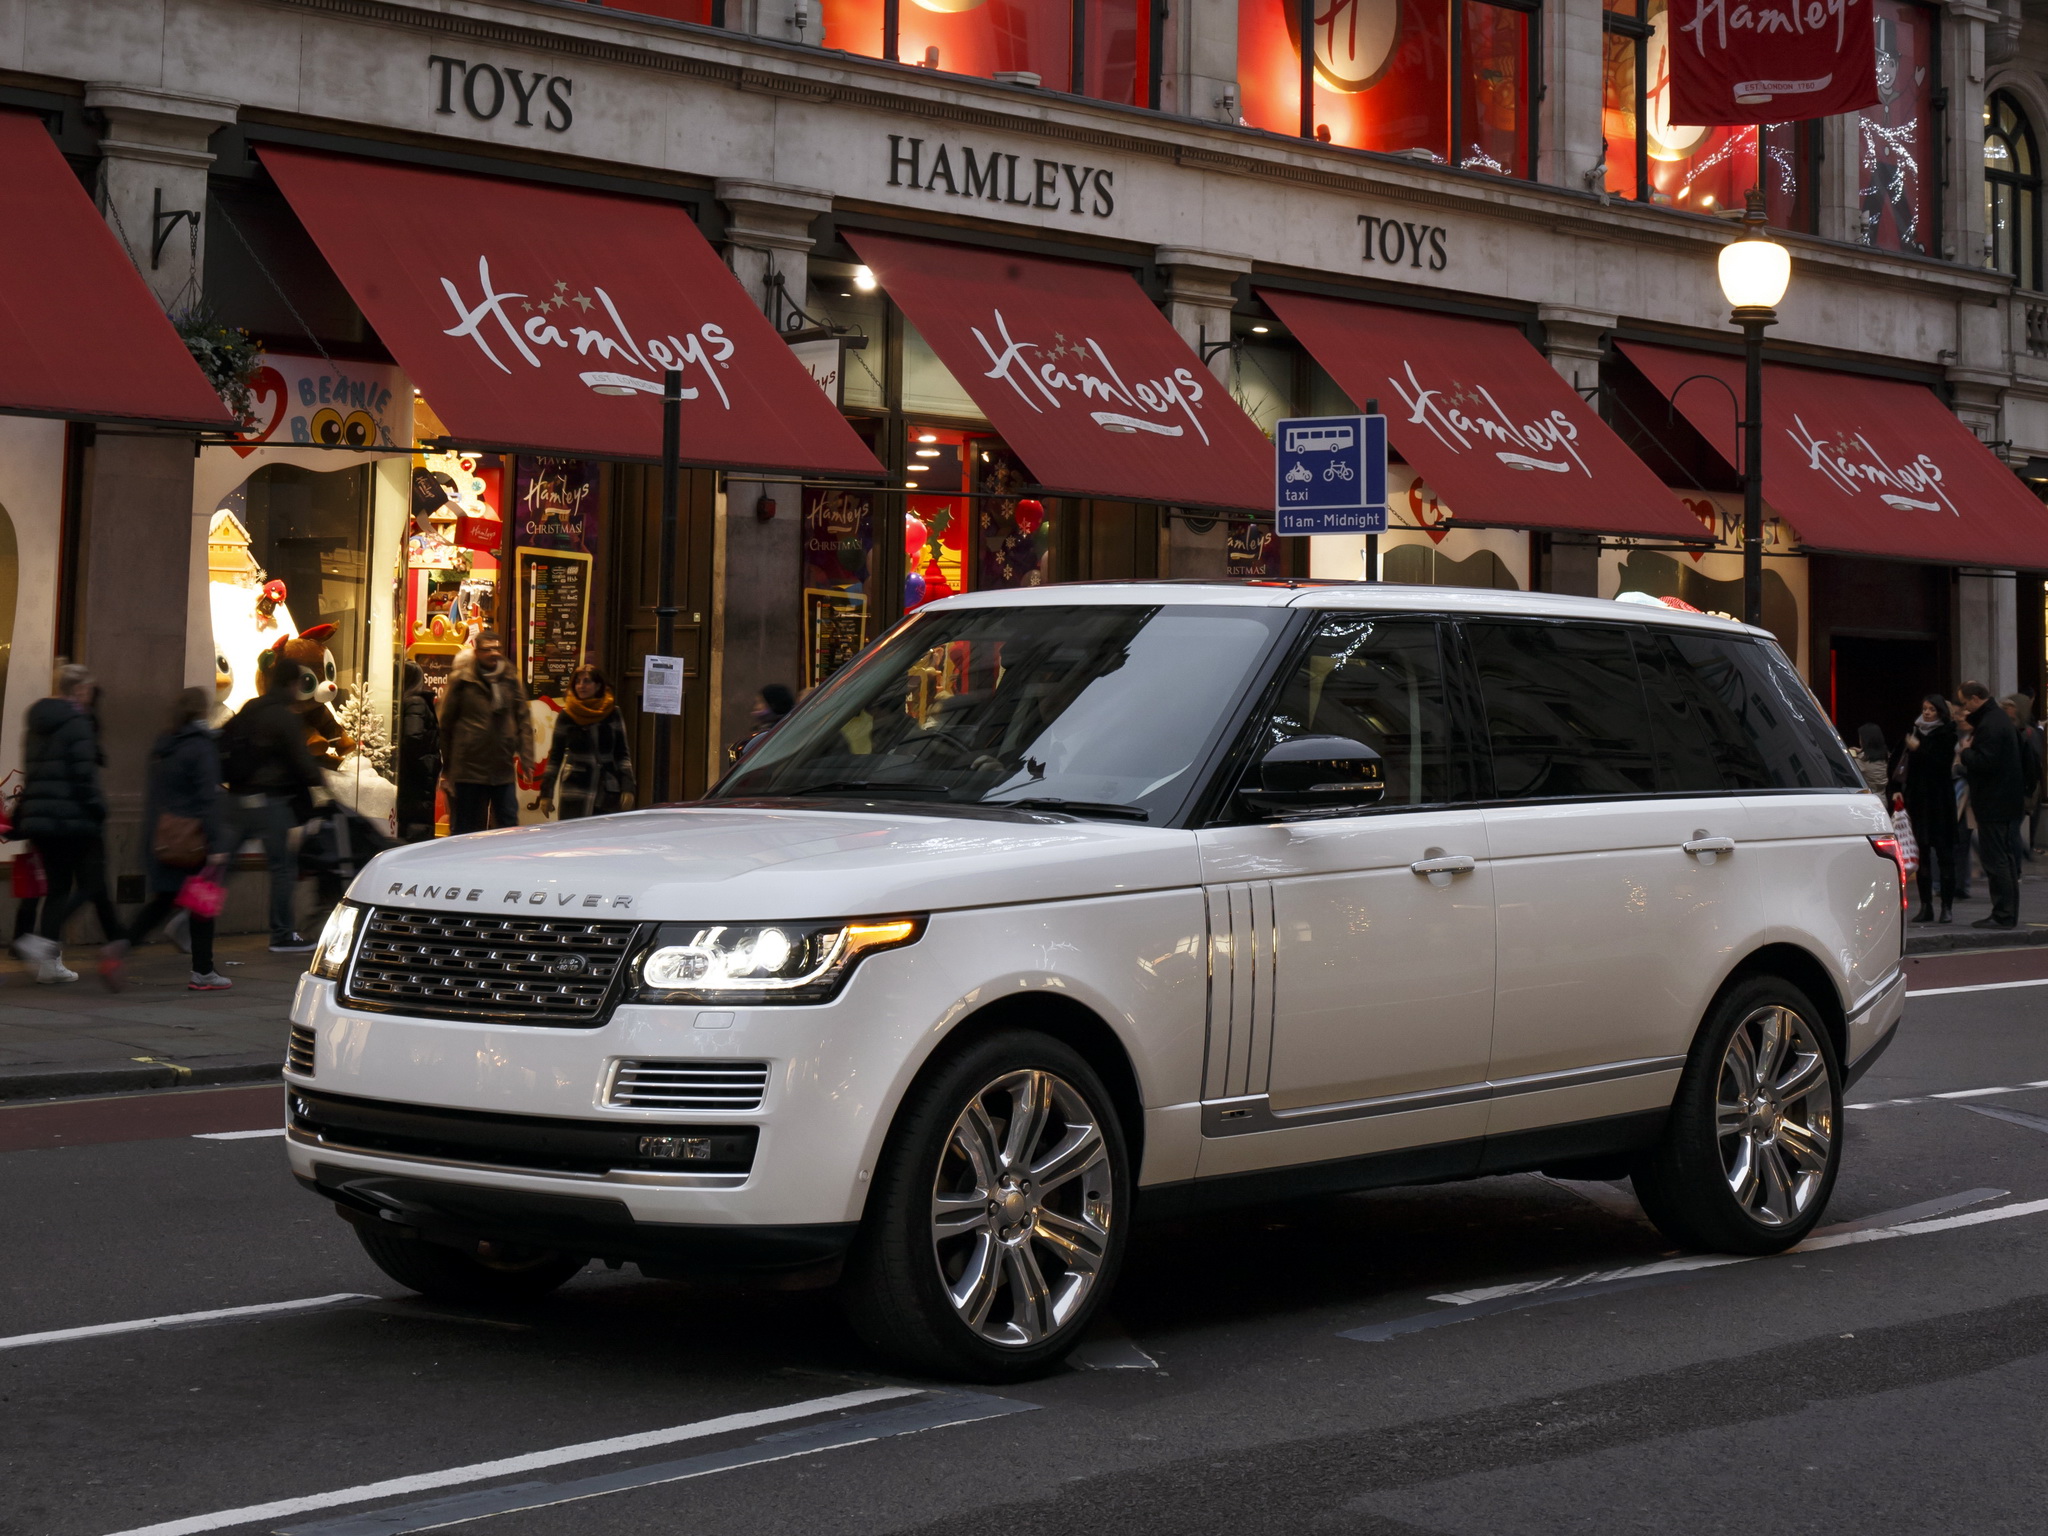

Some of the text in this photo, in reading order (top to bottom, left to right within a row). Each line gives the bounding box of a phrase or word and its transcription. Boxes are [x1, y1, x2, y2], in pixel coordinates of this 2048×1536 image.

[1680, 0, 1859, 58] Hamley
[428, 54, 573, 133] TOYS
[1763, 82, 1794, 90] LONDON
[1798, 82, 1815, 90] 1760
[886, 134, 1114, 218] HAMLEYS
[1357, 214, 1447, 271] TOYS
[440, 255, 734, 410] Hamleys
[298, 375, 392, 414] BEANIE
[970, 308, 1209, 446] Hamleys
[1388, 360, 1592, 478] Hamleys
[1786, 413, 1960, 517] Hamleys
[523, 469, 589, 516] Hamleys
[807, 490, 869, 534] Hamleys
[1285, 488, 1309, 501] taxi
[526, 520, 583, 535] CHRISTMAS!
[1323, 513, 1380, 528] Midnight
[809, 538, 863, 551] CHRISTMAS!
[1227, 523, 1272, 561] amleys
[1226, 564, 1267, 576] RISTMAS!
[423, 673, 448, 687] Spend
[387, 882, 484, 901] RANGE
[503, 890, 634, 909] ROVER
